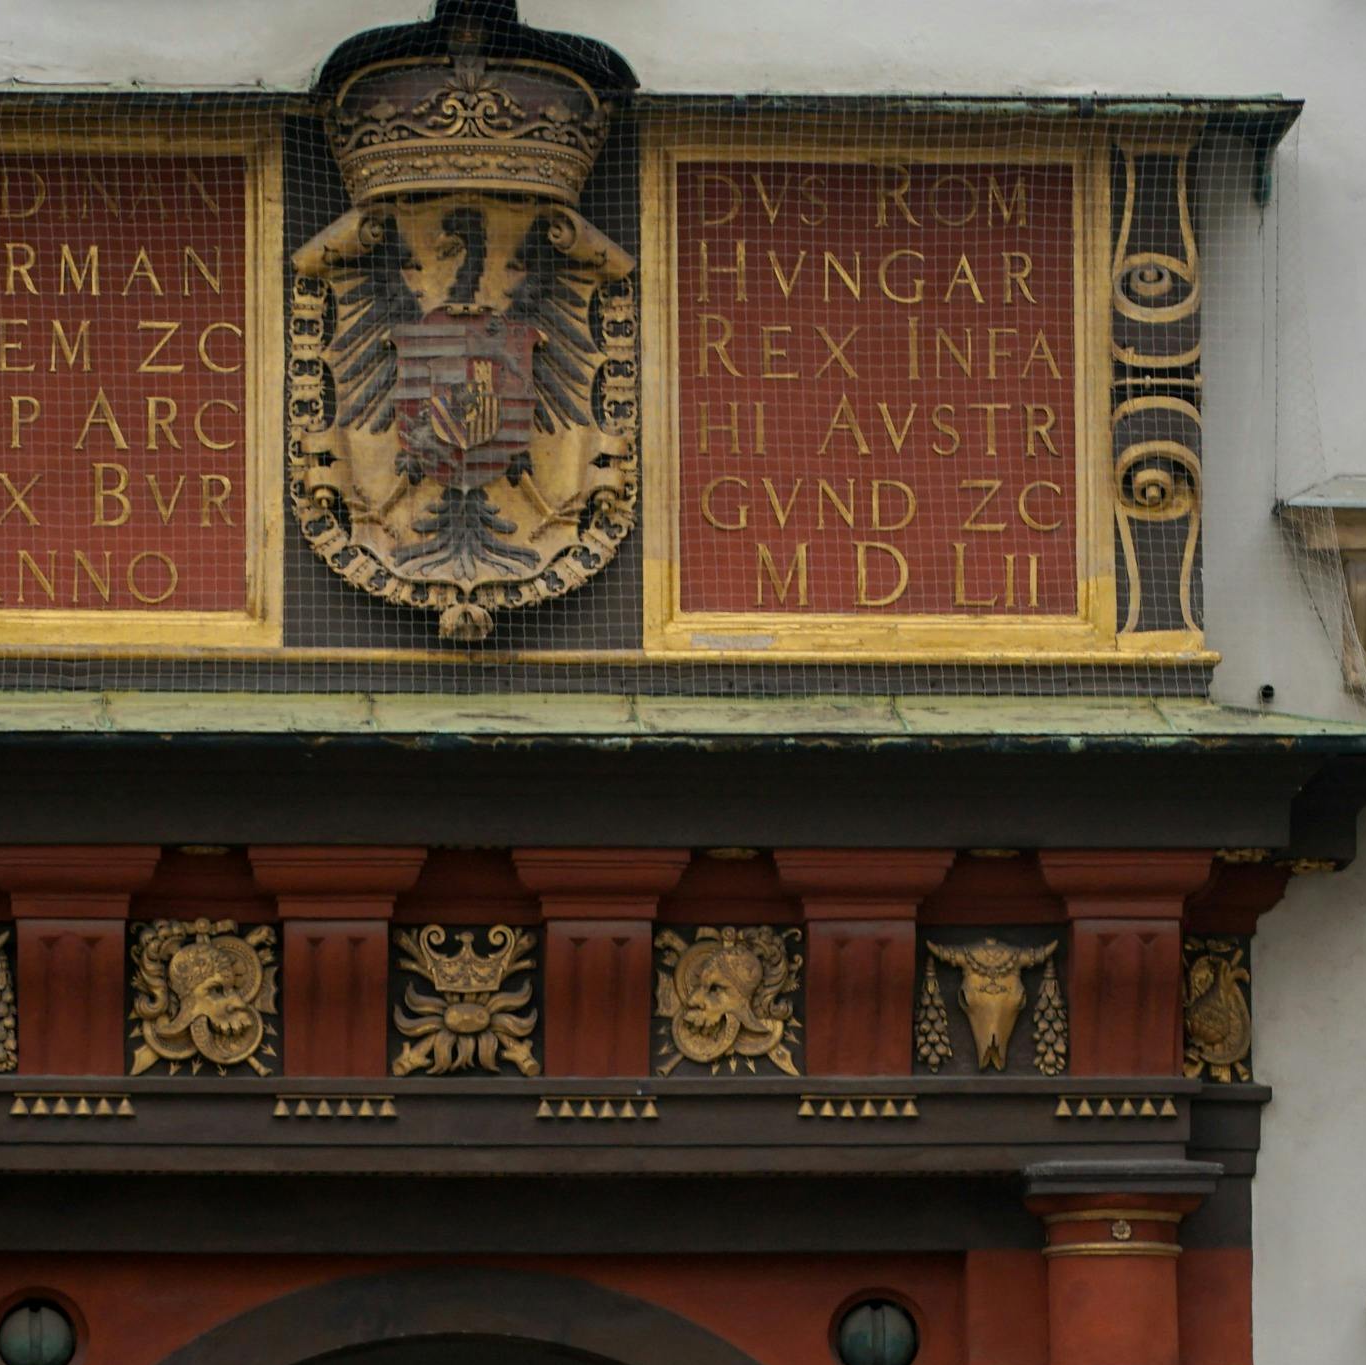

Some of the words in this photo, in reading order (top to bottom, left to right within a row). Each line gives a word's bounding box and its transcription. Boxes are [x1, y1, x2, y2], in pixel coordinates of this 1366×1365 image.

[697, 175, 830, 227] DVS
[875, 164, 1029, 228] ROM
[697, 239, 1038, 304] HVNGAR
[697, 313, 860, 379] REX
[908, 316, 1063, 380] INFA
[74, 387, 239, 450] ARC
[698, 401, 767, 456] HI
[818, 394, 1060, 457] AVSTR
[93, 463, 237, 528] BVR
[700, 476, 917, 531] GVND
